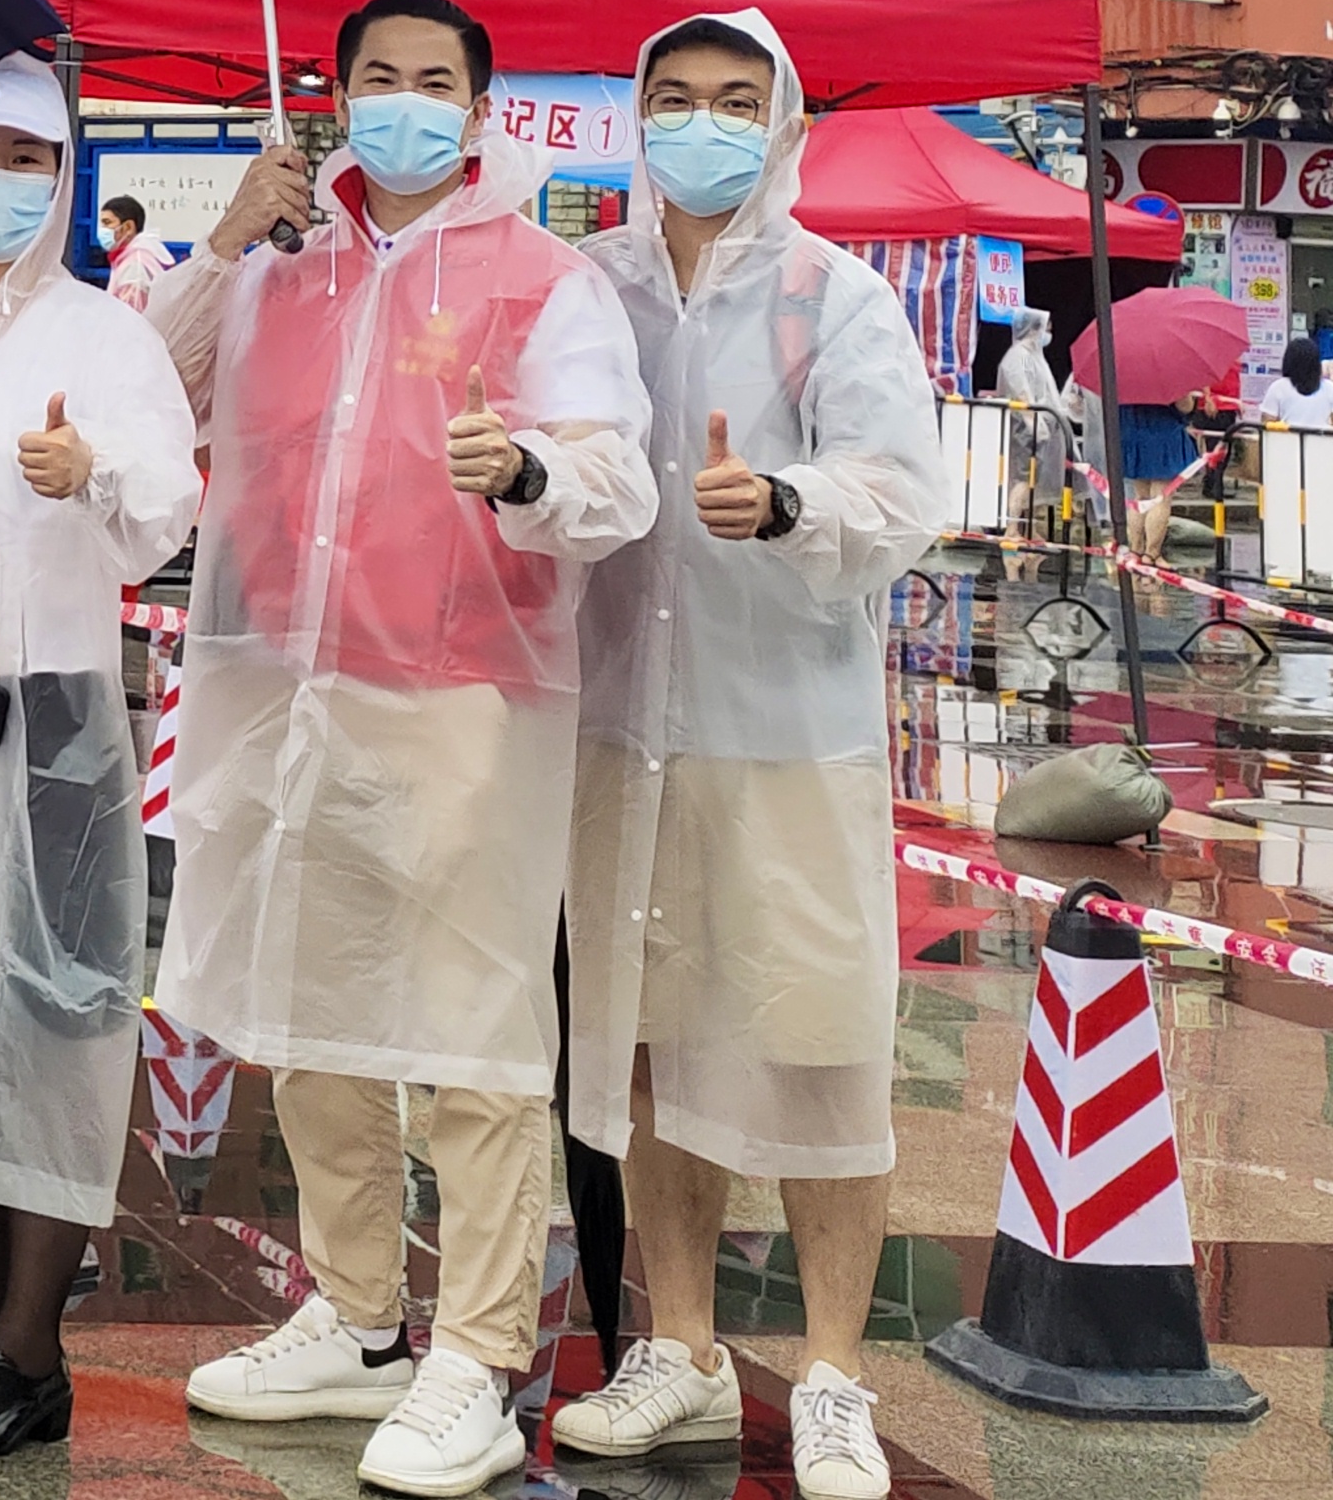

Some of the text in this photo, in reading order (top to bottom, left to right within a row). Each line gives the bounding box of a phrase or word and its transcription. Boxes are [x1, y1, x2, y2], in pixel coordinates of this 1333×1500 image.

[989, 252, 1012, 274] 便民
[985, 283, 1019, 307] 服务区
